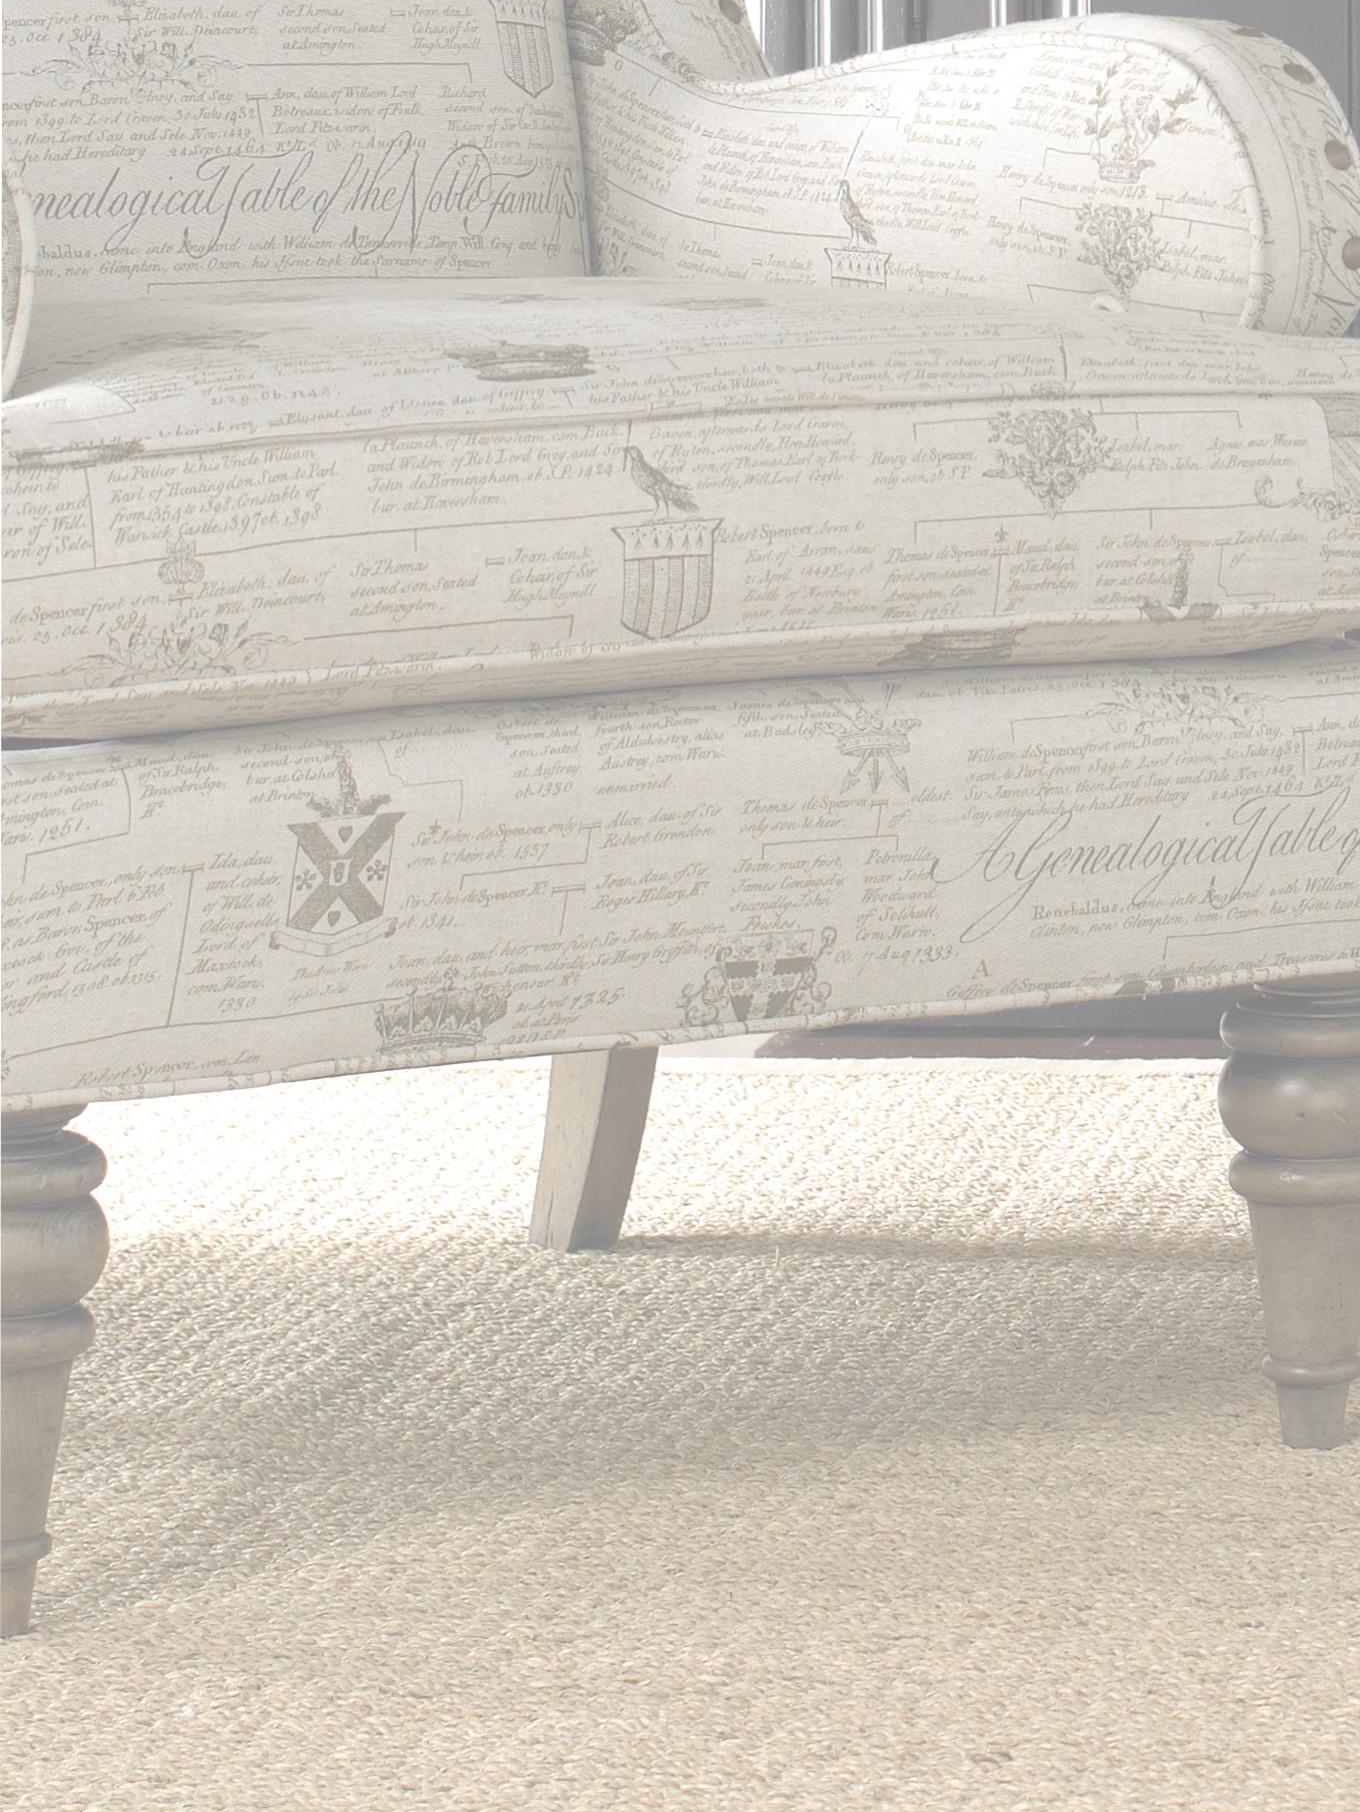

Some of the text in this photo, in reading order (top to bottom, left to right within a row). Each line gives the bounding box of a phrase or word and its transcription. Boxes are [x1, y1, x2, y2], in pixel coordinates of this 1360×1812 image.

[312, 153, 364, 234] of
[343, 130, 412, 215] the
[352, 144, 493, 255] Noble
[960, 806, 1267, 943] Genealogical
